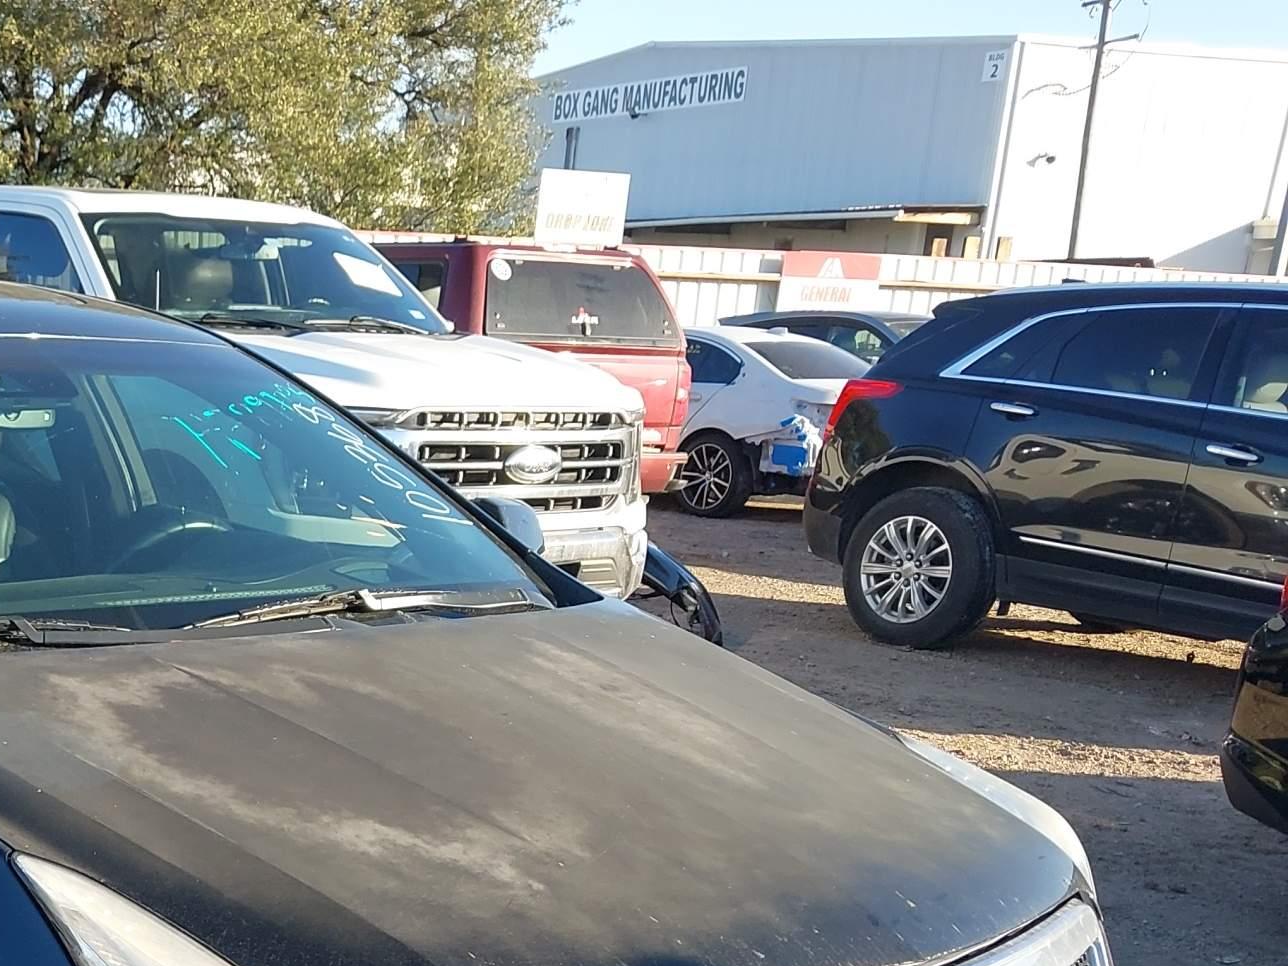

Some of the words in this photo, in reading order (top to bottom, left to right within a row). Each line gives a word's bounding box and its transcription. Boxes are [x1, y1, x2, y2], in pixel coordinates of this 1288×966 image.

[990, 64, 999, 78] 2
[554, 93, 581, 120] BOX
[582, 86, 620, 117] GANG
[622, 69, 746, 112] MANUFACTURING
[800, 285, 852, 303] GENERAL
